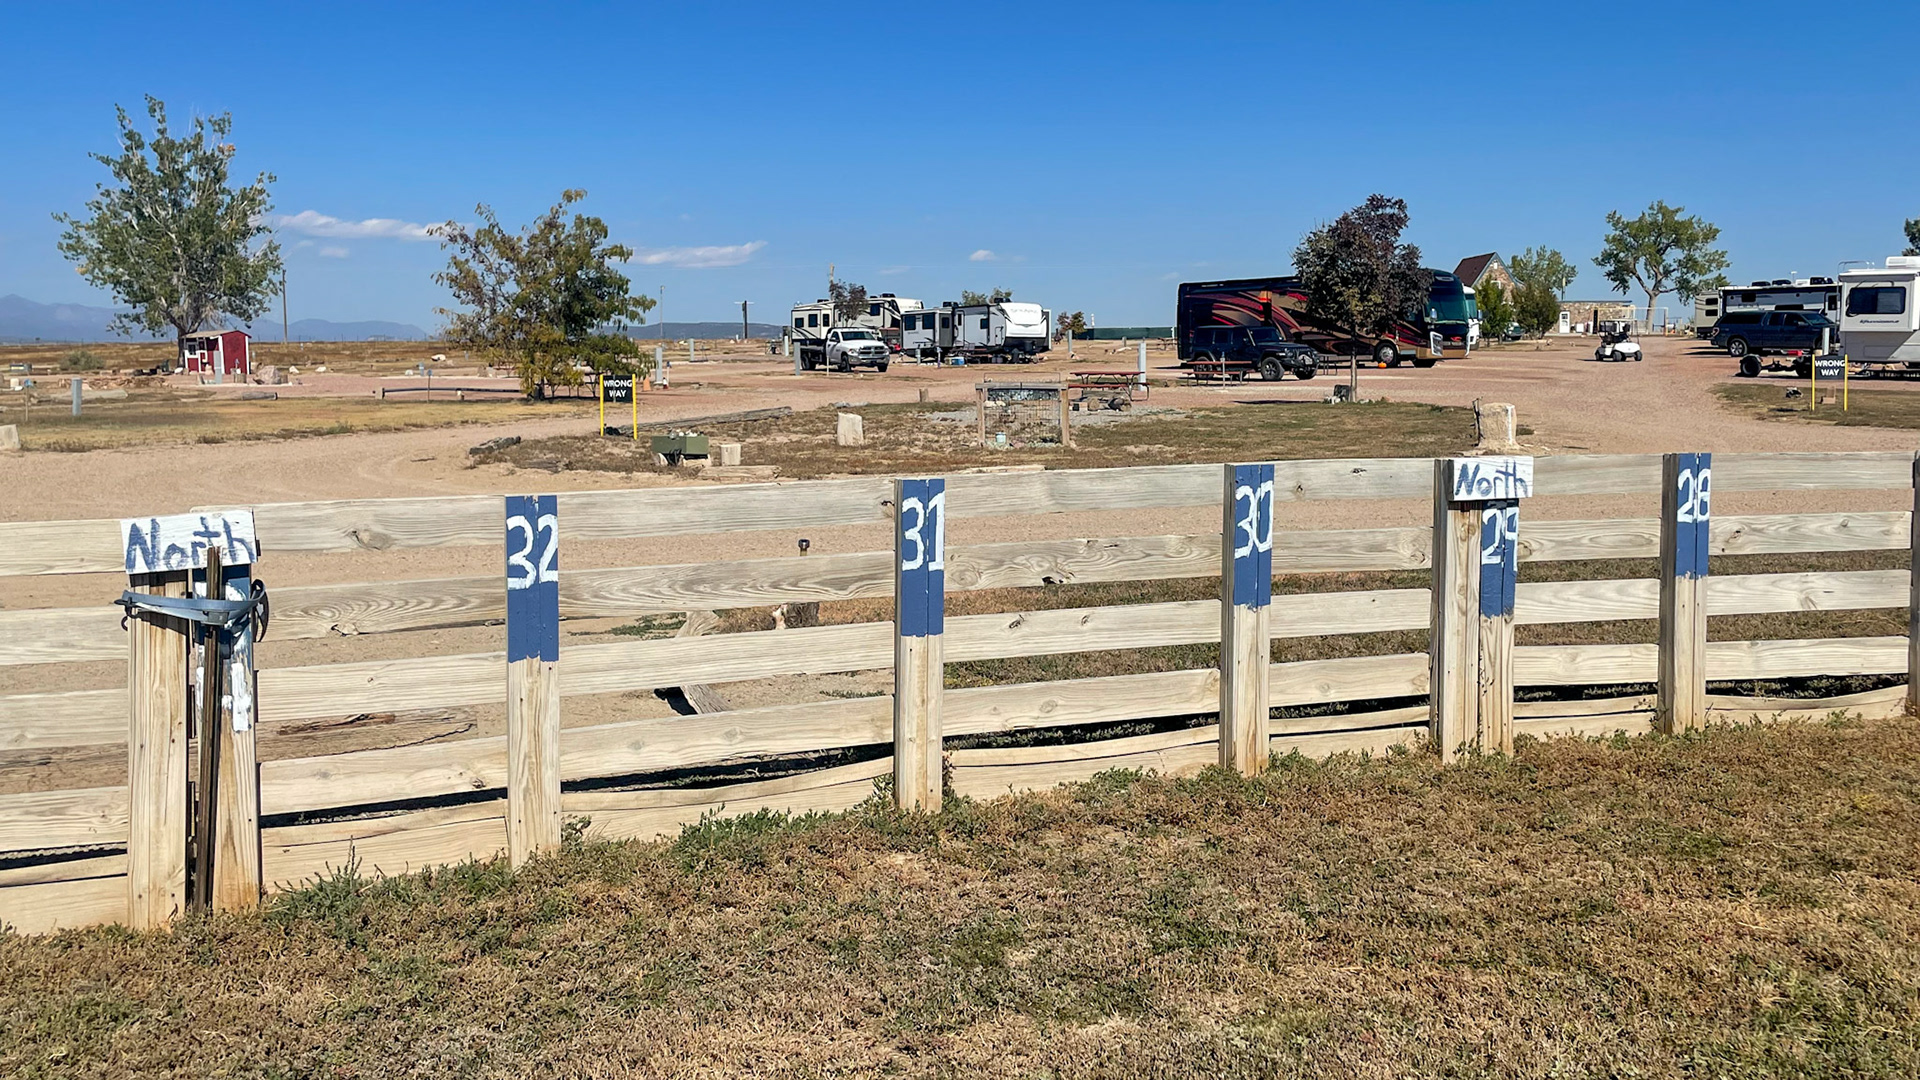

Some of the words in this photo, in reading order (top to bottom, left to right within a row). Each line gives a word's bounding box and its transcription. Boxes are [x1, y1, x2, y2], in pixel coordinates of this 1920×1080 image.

[603, 379, 633, 388] WRONG
[1814, 359, 1846, 367] WRONG
[1820, 368, 1840, 376] WAY
[608, 389, 627, 398] WAY
[1454, 459, 1529, 499] North
[1677, 468, 1711, 524] 28
[125, 516, 256, 573] North
[901, 490, 945, 572] 31
[1234, 480, 1274, 559] 30
[1481, 500, 1519, 572] 29
[506, 513, 559, 591] 32
